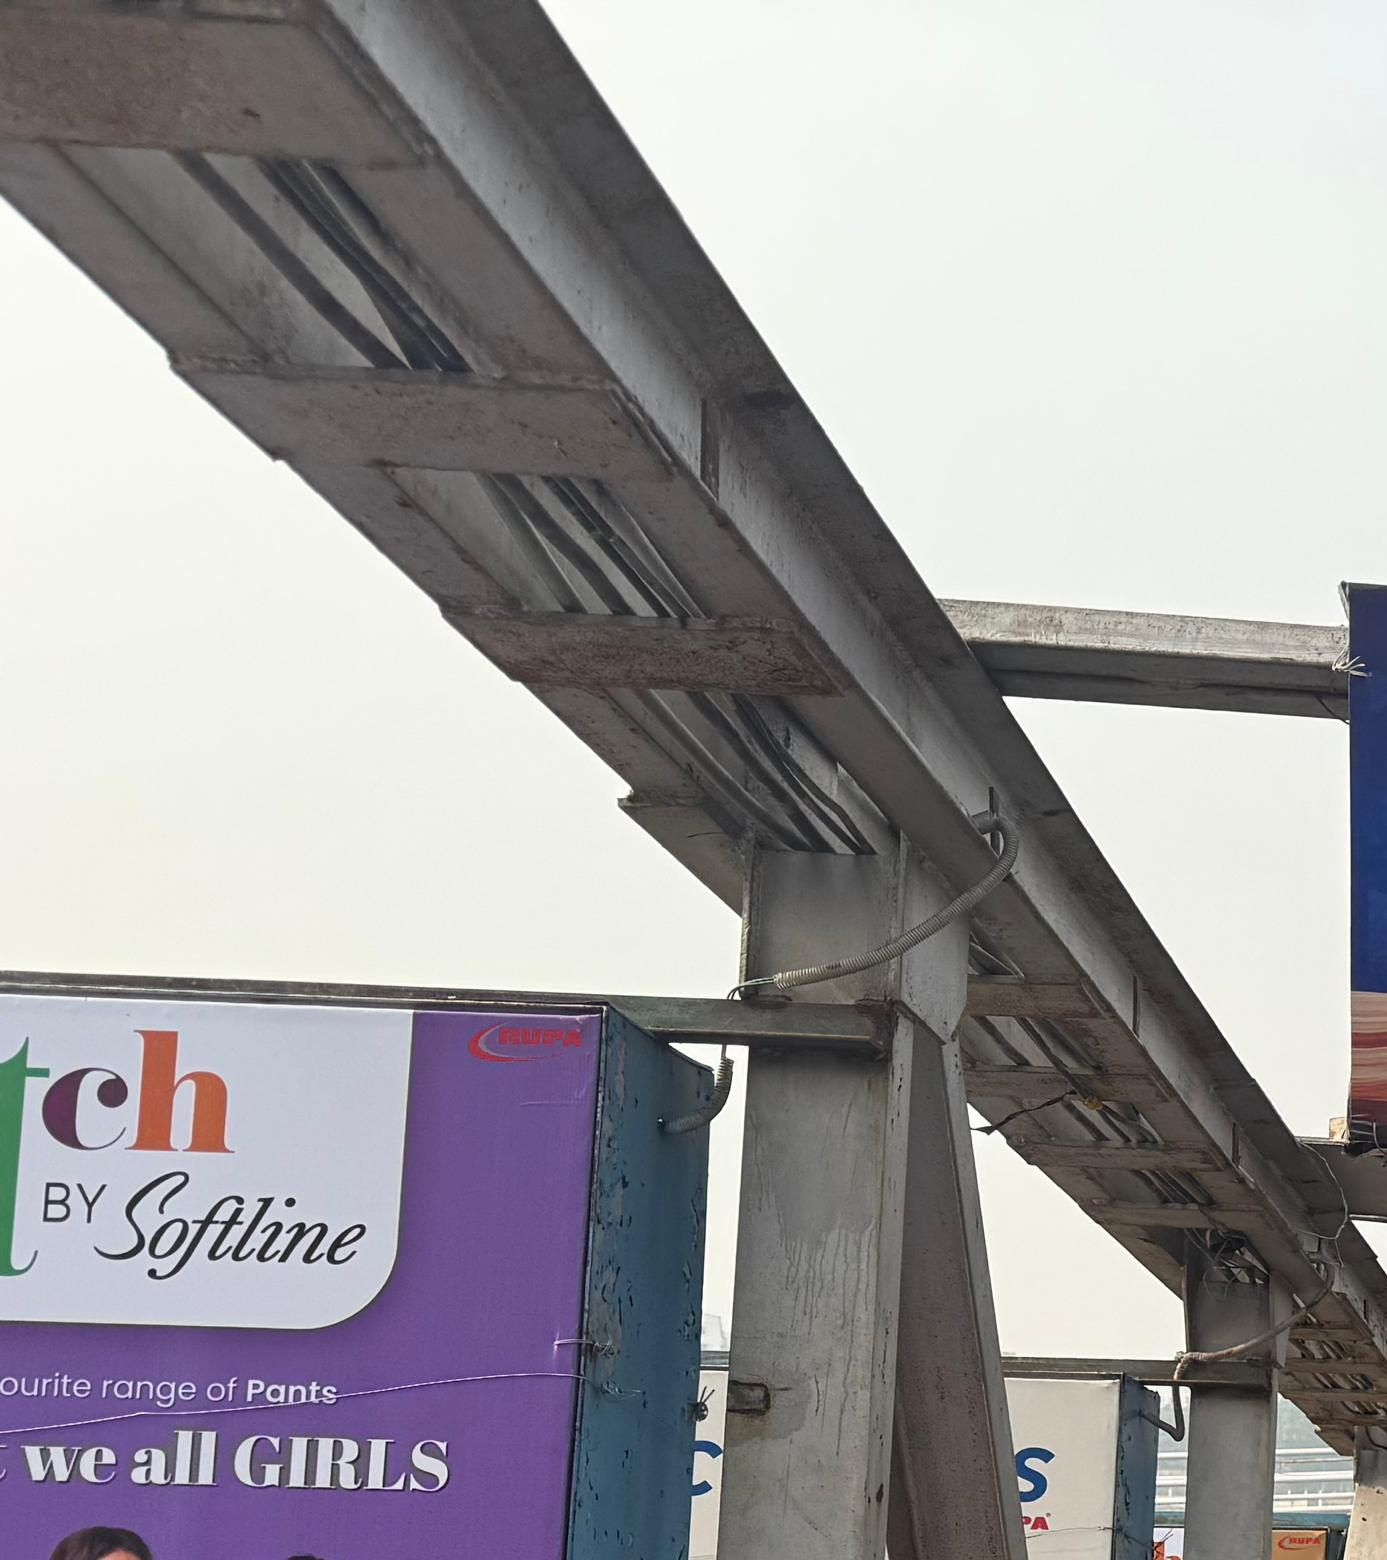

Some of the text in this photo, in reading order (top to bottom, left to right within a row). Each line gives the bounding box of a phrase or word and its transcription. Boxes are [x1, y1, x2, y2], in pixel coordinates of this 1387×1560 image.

[499, 1025, 584, 1049] RUPA
[43, 1170, 368, 1281] BY Softline
[0, 1373, 338, 1408] ourite range of Pants
[20, 1443, 117, 1485] we
[131, 1429, 219, 1486] all
[233, 1434, 450, 1493] GIRLS
